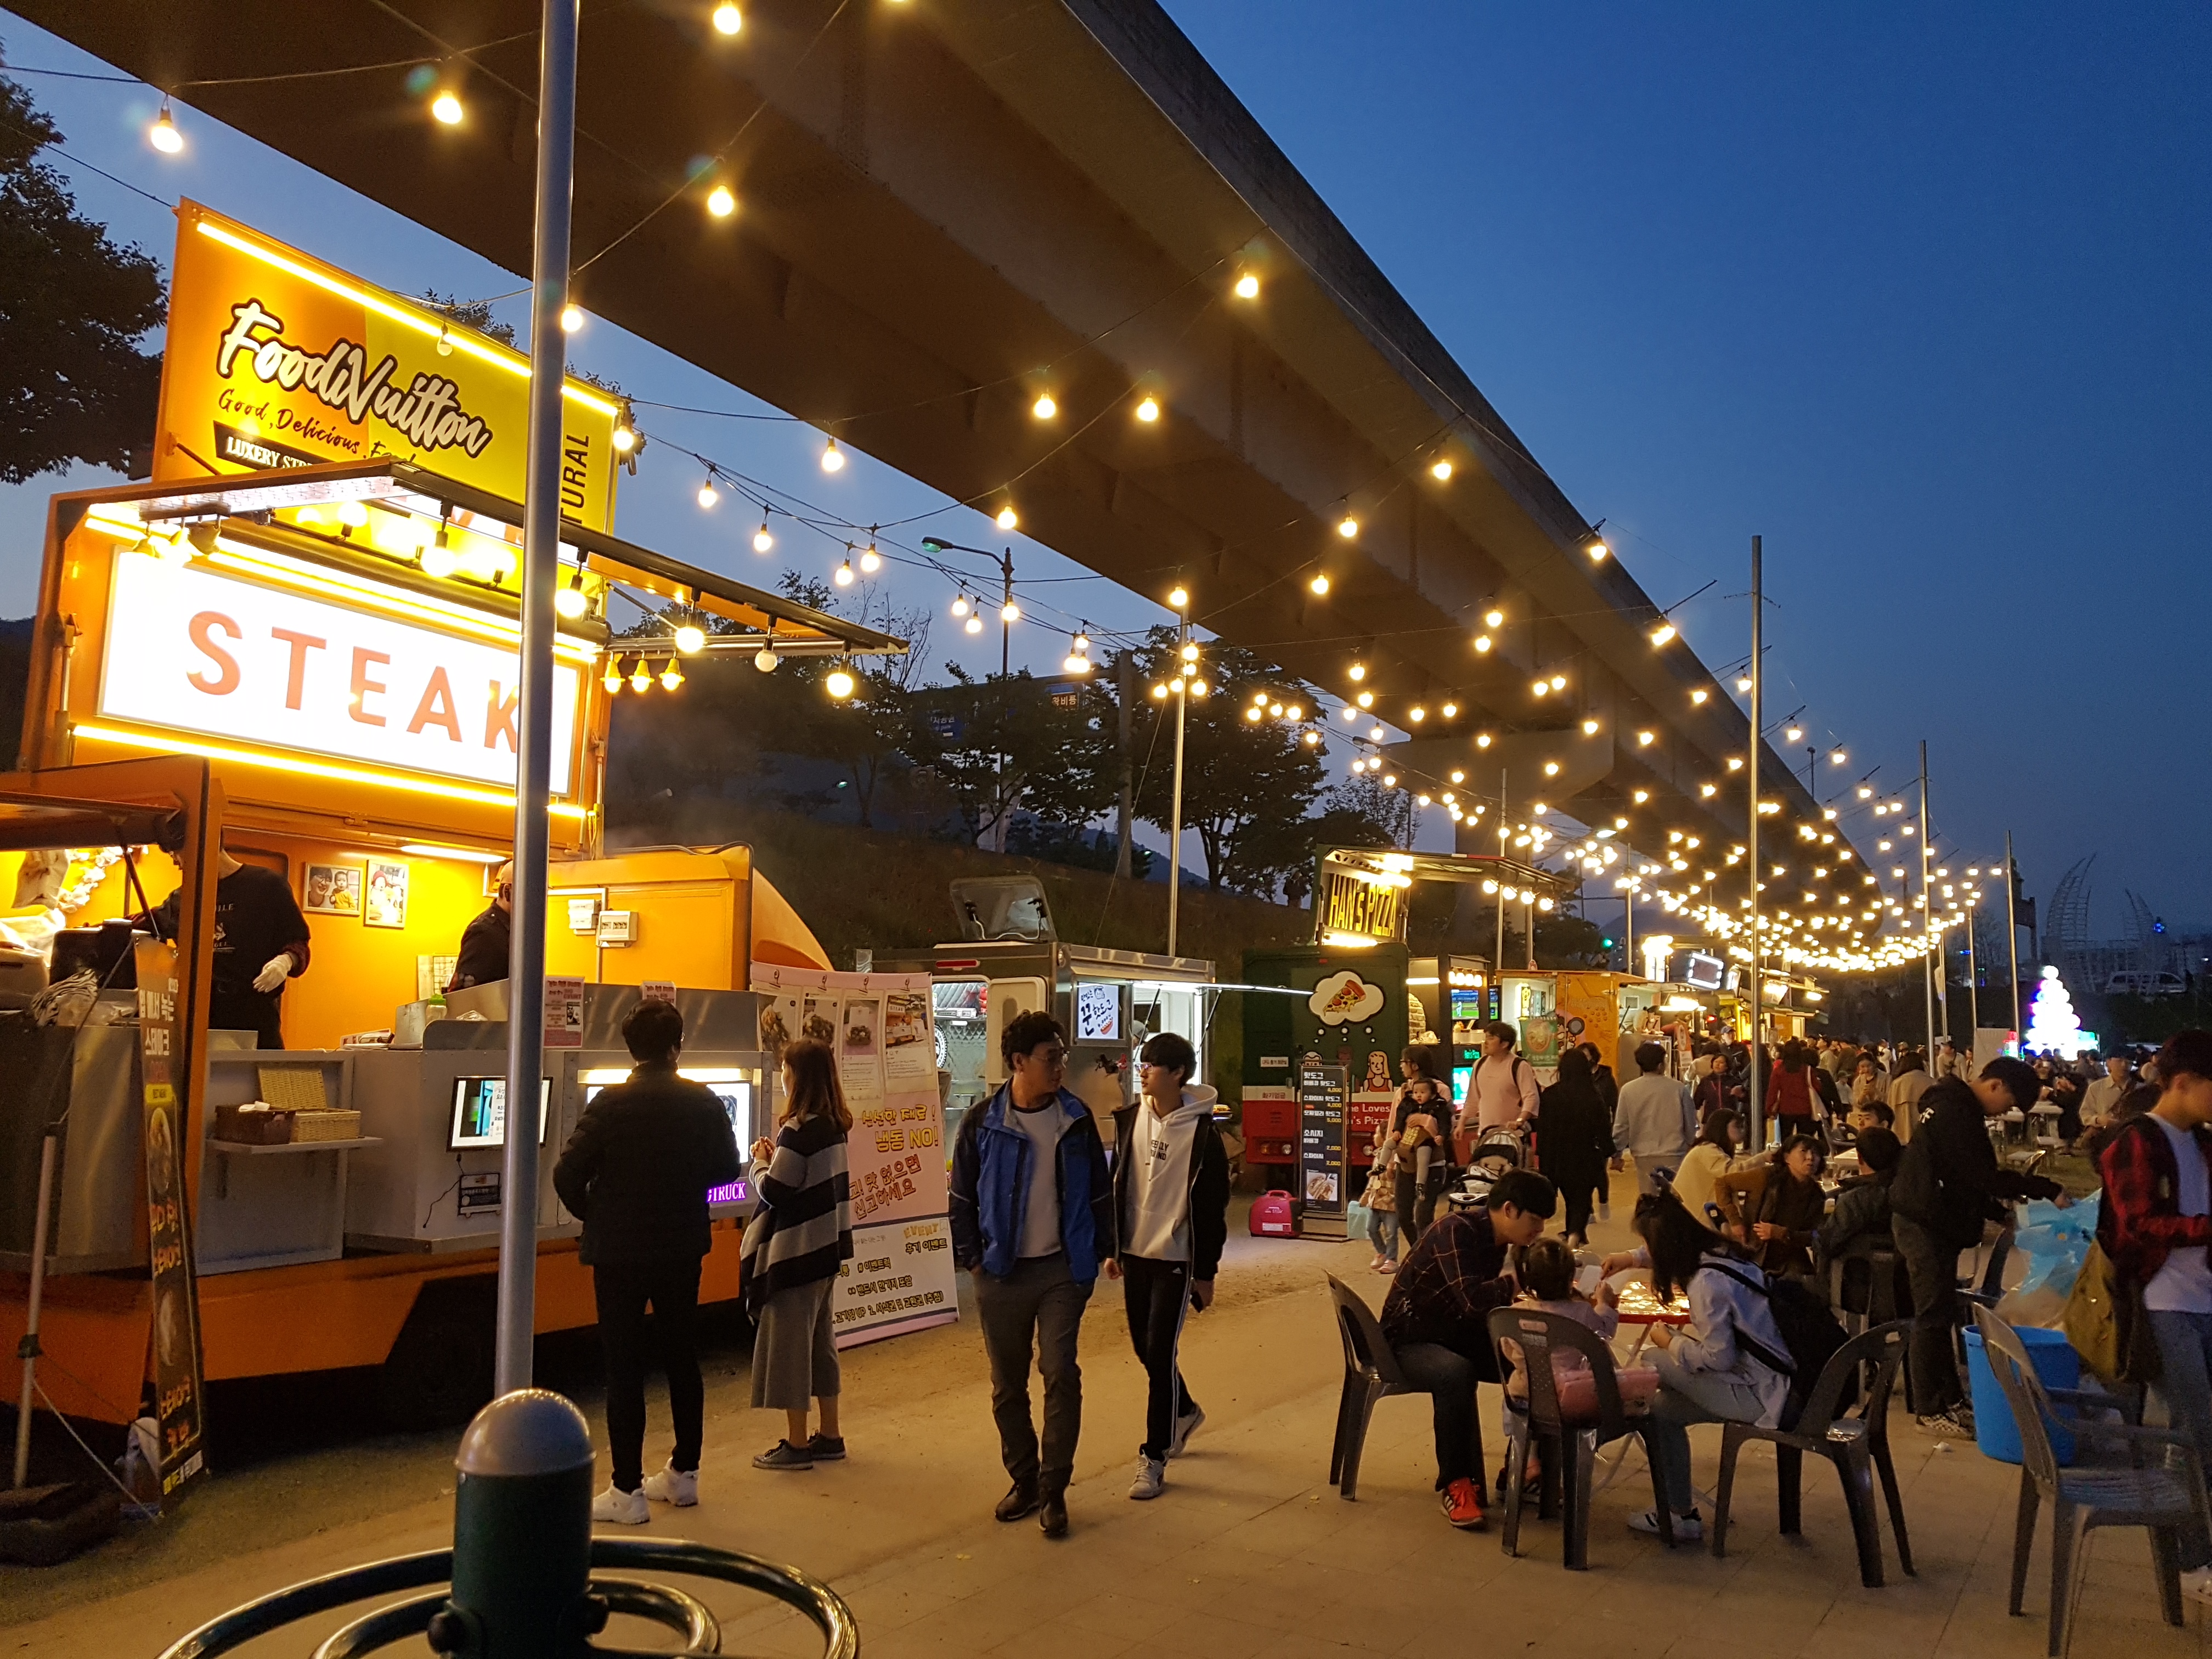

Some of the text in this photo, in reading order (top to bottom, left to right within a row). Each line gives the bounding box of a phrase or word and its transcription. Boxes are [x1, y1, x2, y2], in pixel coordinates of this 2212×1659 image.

[227, 437, 281, 467] LUXERY
[186, 611, 518, 753] STEAK
[1329, 873, 1397, 938] HAN's PIZZA
[145, 1028, 170, 1056] 스테이크
[862, 1107, 897, 1127] 신선한
[900, 1104, 927, 1121] 재료
[1362, 1103, 1390, 1113] Loves
[875, 1125, 939, 1153] 냉동 NO!
[864, 1171, 879, 1192] 맛
[879, 1154, 922, 1186] 없으면
[854, 1178, 916, 1220] 신고하세요
[904, 1222, 939, 1239] EVENT
[906, 1238, 948, 1254] 후기 이벤트
[856, 1282, 878, 1296] 반드시
[898, 1274, 913, 1288] 포함
[855, 1306, 866, 1318] UP
[876, 1300, 897, 1314] 시식권
[903, 1295, 924, 1308] 교환권
[924, 1290, 944, 1305] (추첨)
